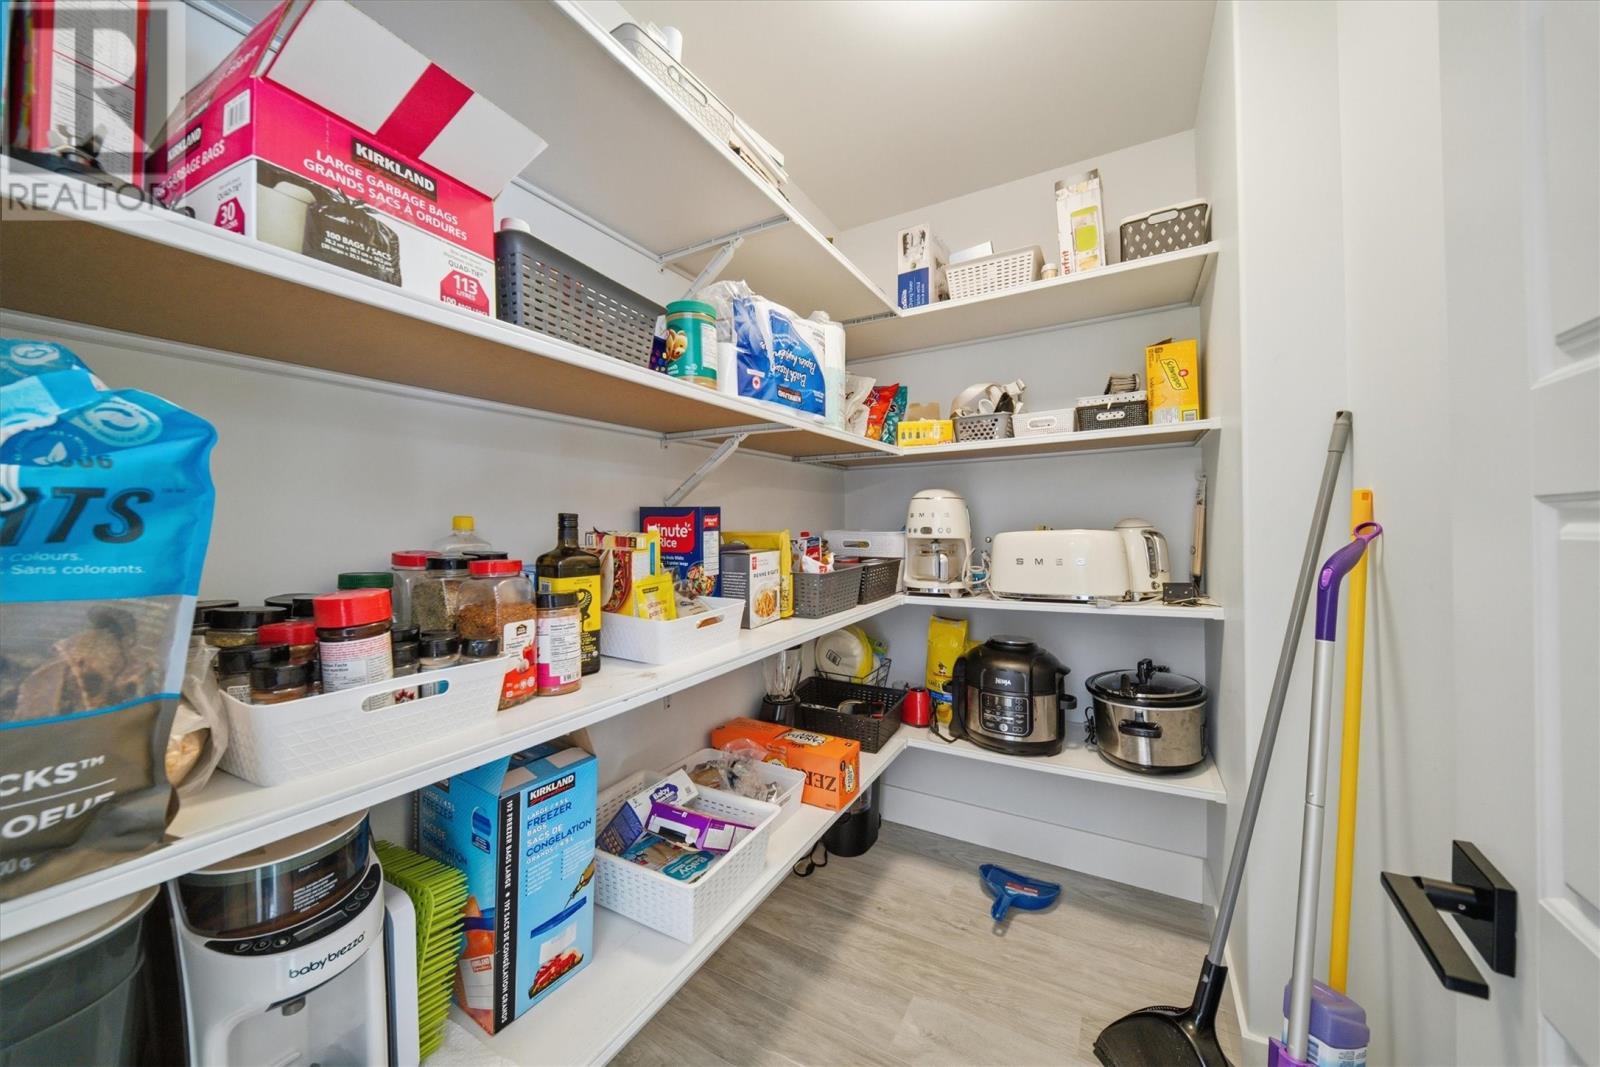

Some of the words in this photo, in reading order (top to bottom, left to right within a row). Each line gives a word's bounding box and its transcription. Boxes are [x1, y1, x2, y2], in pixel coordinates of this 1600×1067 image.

[201, 139, 225, 166] BAGS
[355, 142, 435, 192] KIRKLAND
[303, 158, 366, 194] GRANDS
[368, 187, 401, 210] SACS
[404, 201, 414, 217] À
[416, 211, 468, 242] ORDURES
[316, 149, 363, 180] LARGE
[366, 173, 426, 210] GARBAGE
[428, 204, 459, 226] BAGS
[220, 201, 236, 225] 30
[325, 230, 341, 242] 100
[342, 236, 365, 251] BAGS
[371, 247, 392, 261] SACS
[452, 274, 478, 296] 113
[659, 537, 678, 549] Rice
[10, 564, 58, 575] Sans
[61, 562, 146, 575] colorants.
[11, 552, 83, 563] colours.
[995, 677, 1012, 687] NINJA
[530, 774, 574, 800] KIRKLAND
[798, 768, 837, 793] ZER
[527, 801, 572, 830] FREEZER
[505, 813, 513, 845] FREEZER
[527, 831, 550, 847] SACS
[552, 824, 563, 836] DE
[504, 864, 512, 889] LARGE
[503, 899, 511, 912] 192
[503, 931, 510, 942] DE
